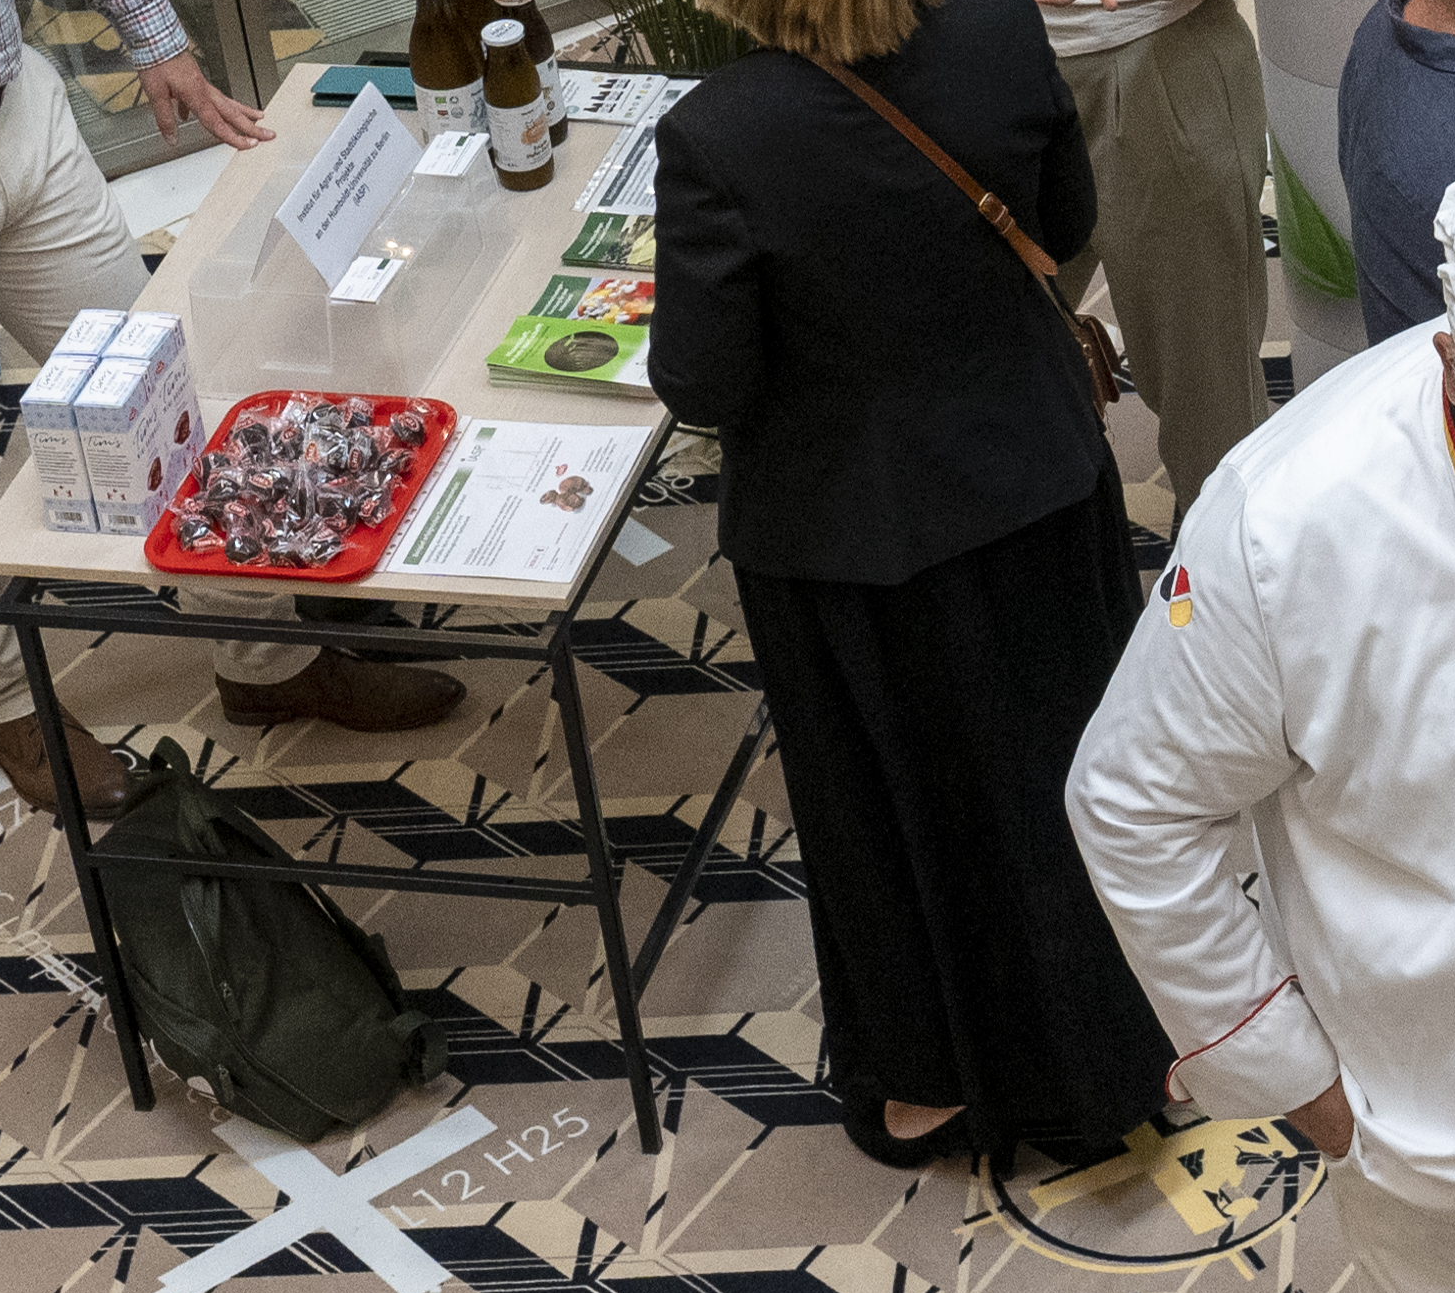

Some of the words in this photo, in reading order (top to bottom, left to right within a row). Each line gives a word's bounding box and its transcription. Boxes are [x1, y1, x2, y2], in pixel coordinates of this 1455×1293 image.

[369, 147, 379, 160] zu
[373, 130, 391, 152] Berlin
[295, 197, 316, 223] Institut
[310, 187, 322, 202] für
[317, 170, 335, 193] Agrar-
[331, 154, 344, 173] und
[338, 107, 378, 161] Stadtökologische
[333, 160, 355, 189] Projekte
[326, 154, 374, 221] Humboldt-Universität
[314, 227, 324, 241] an
[319, 216, 331, 232] der
[390, 1168, 482, 1229] L12
[486, 1107, 591, 1174] H25
